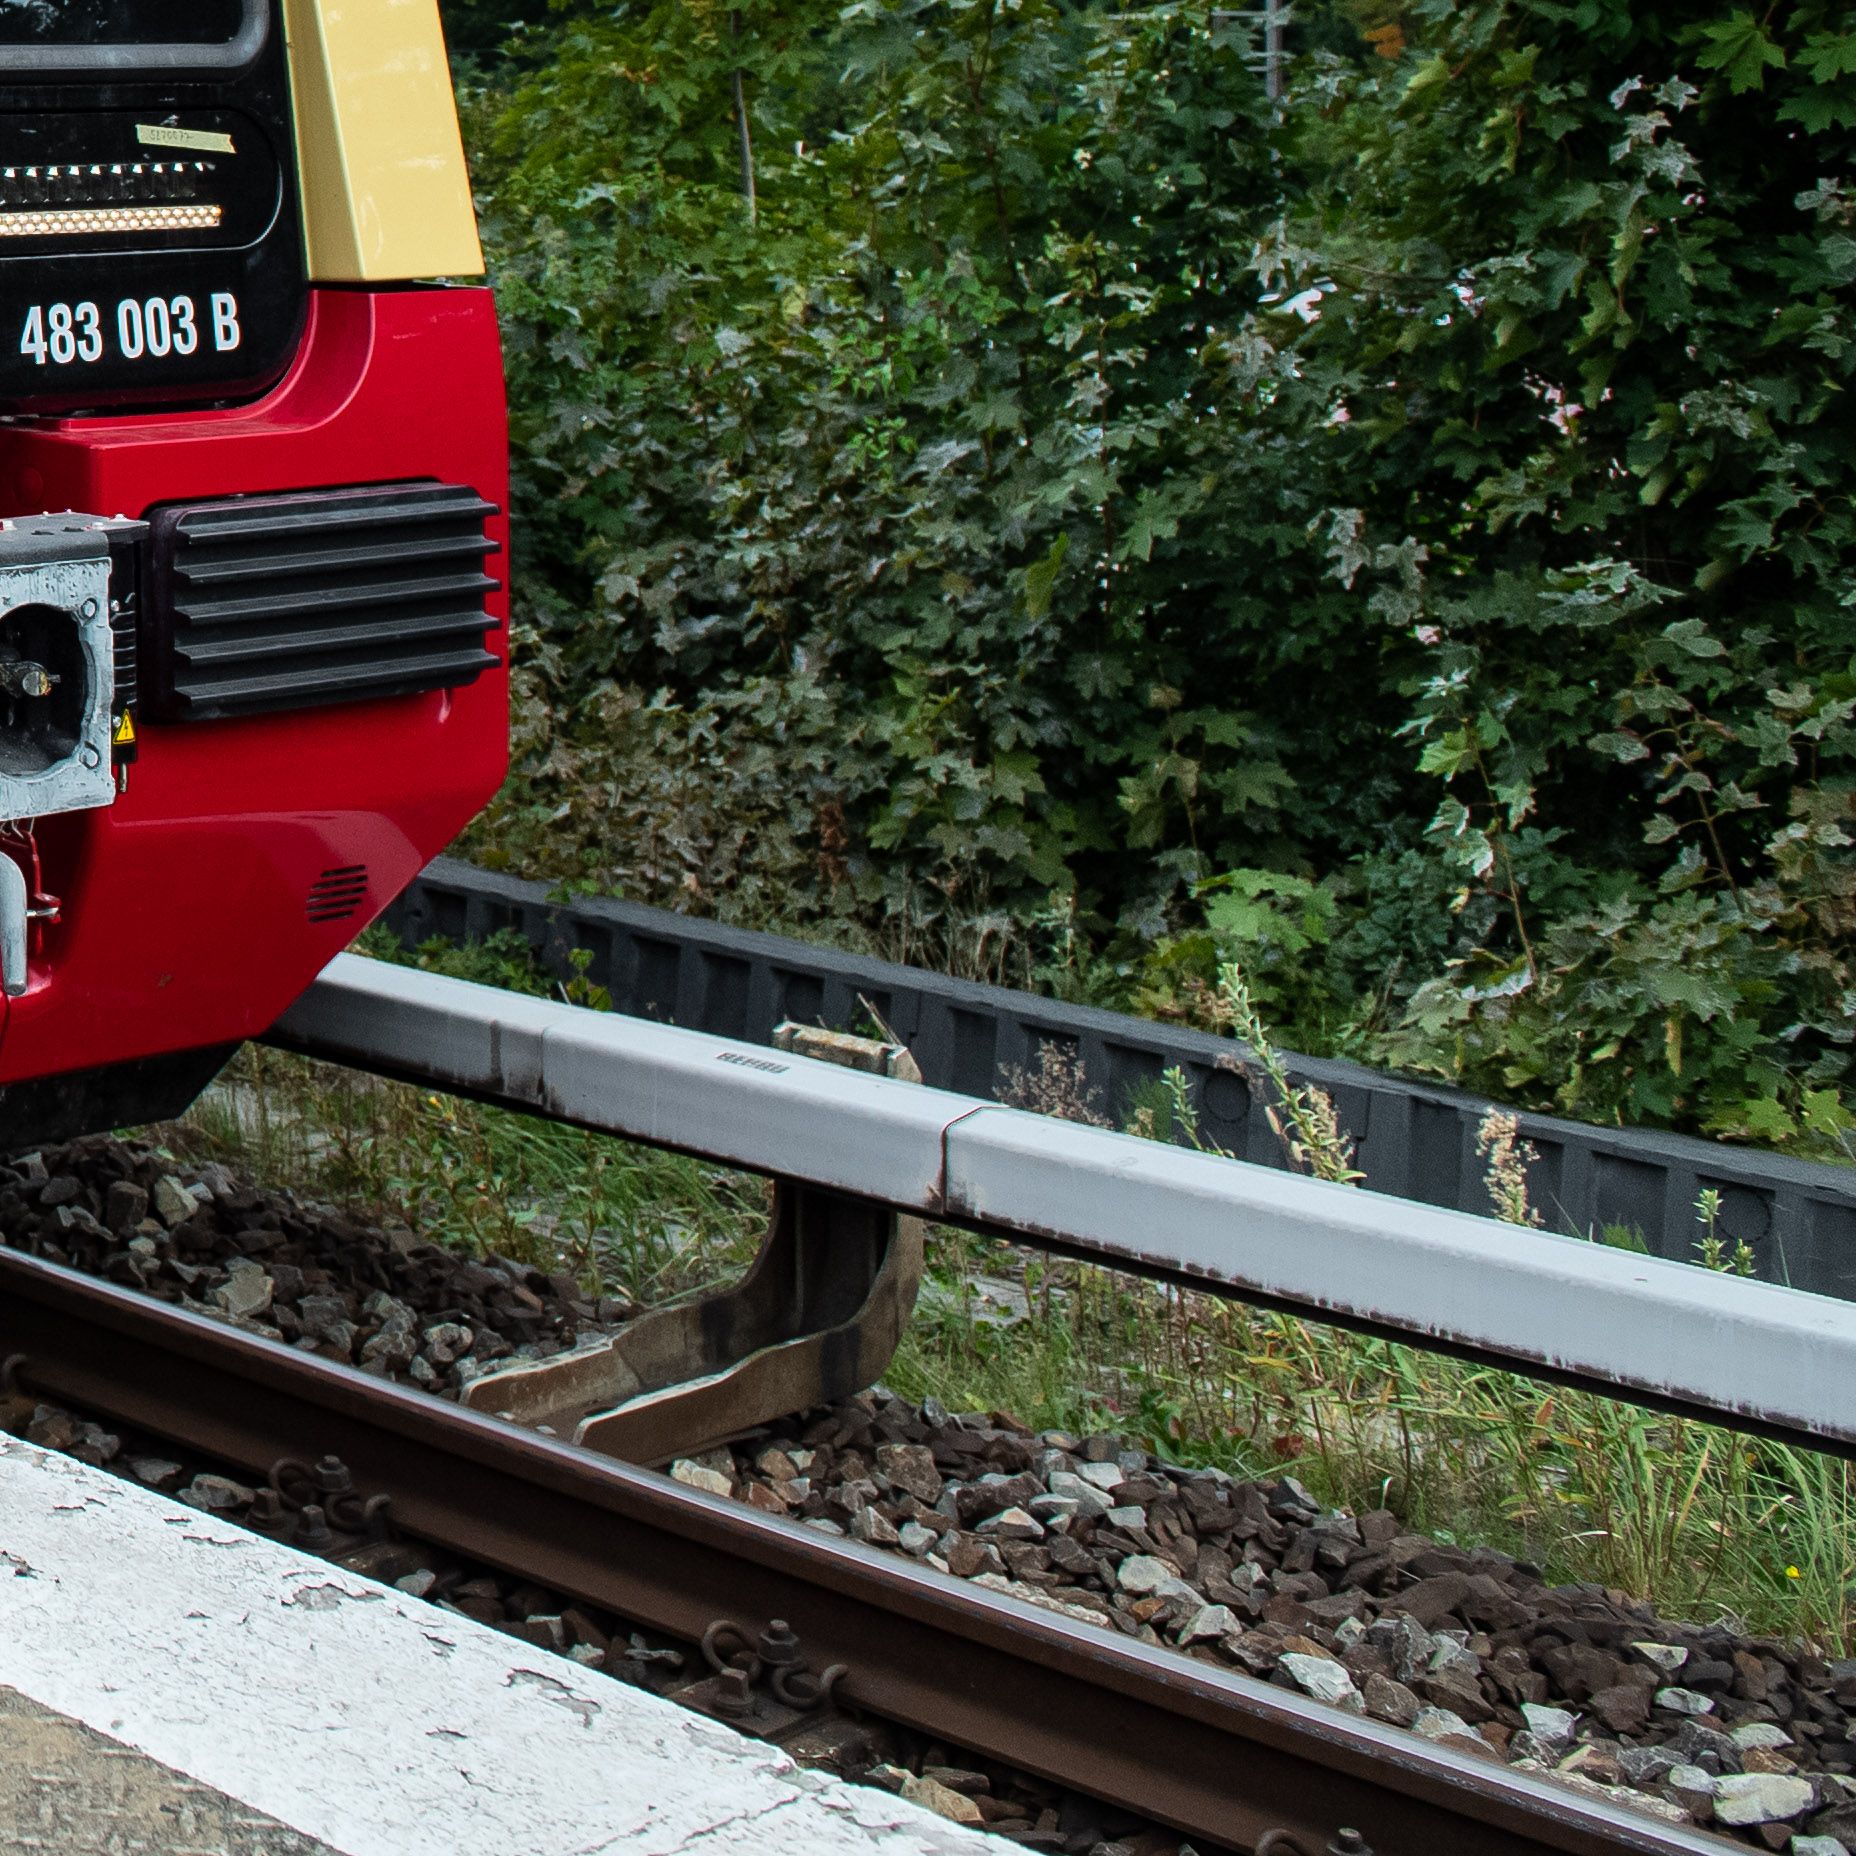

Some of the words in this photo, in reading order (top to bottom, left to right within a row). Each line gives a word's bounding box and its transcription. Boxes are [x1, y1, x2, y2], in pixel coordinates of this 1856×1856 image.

[20, 301, 103, 365] 483
[117, 295, 198, 359] 003
[210, 292, 241, 352] B
